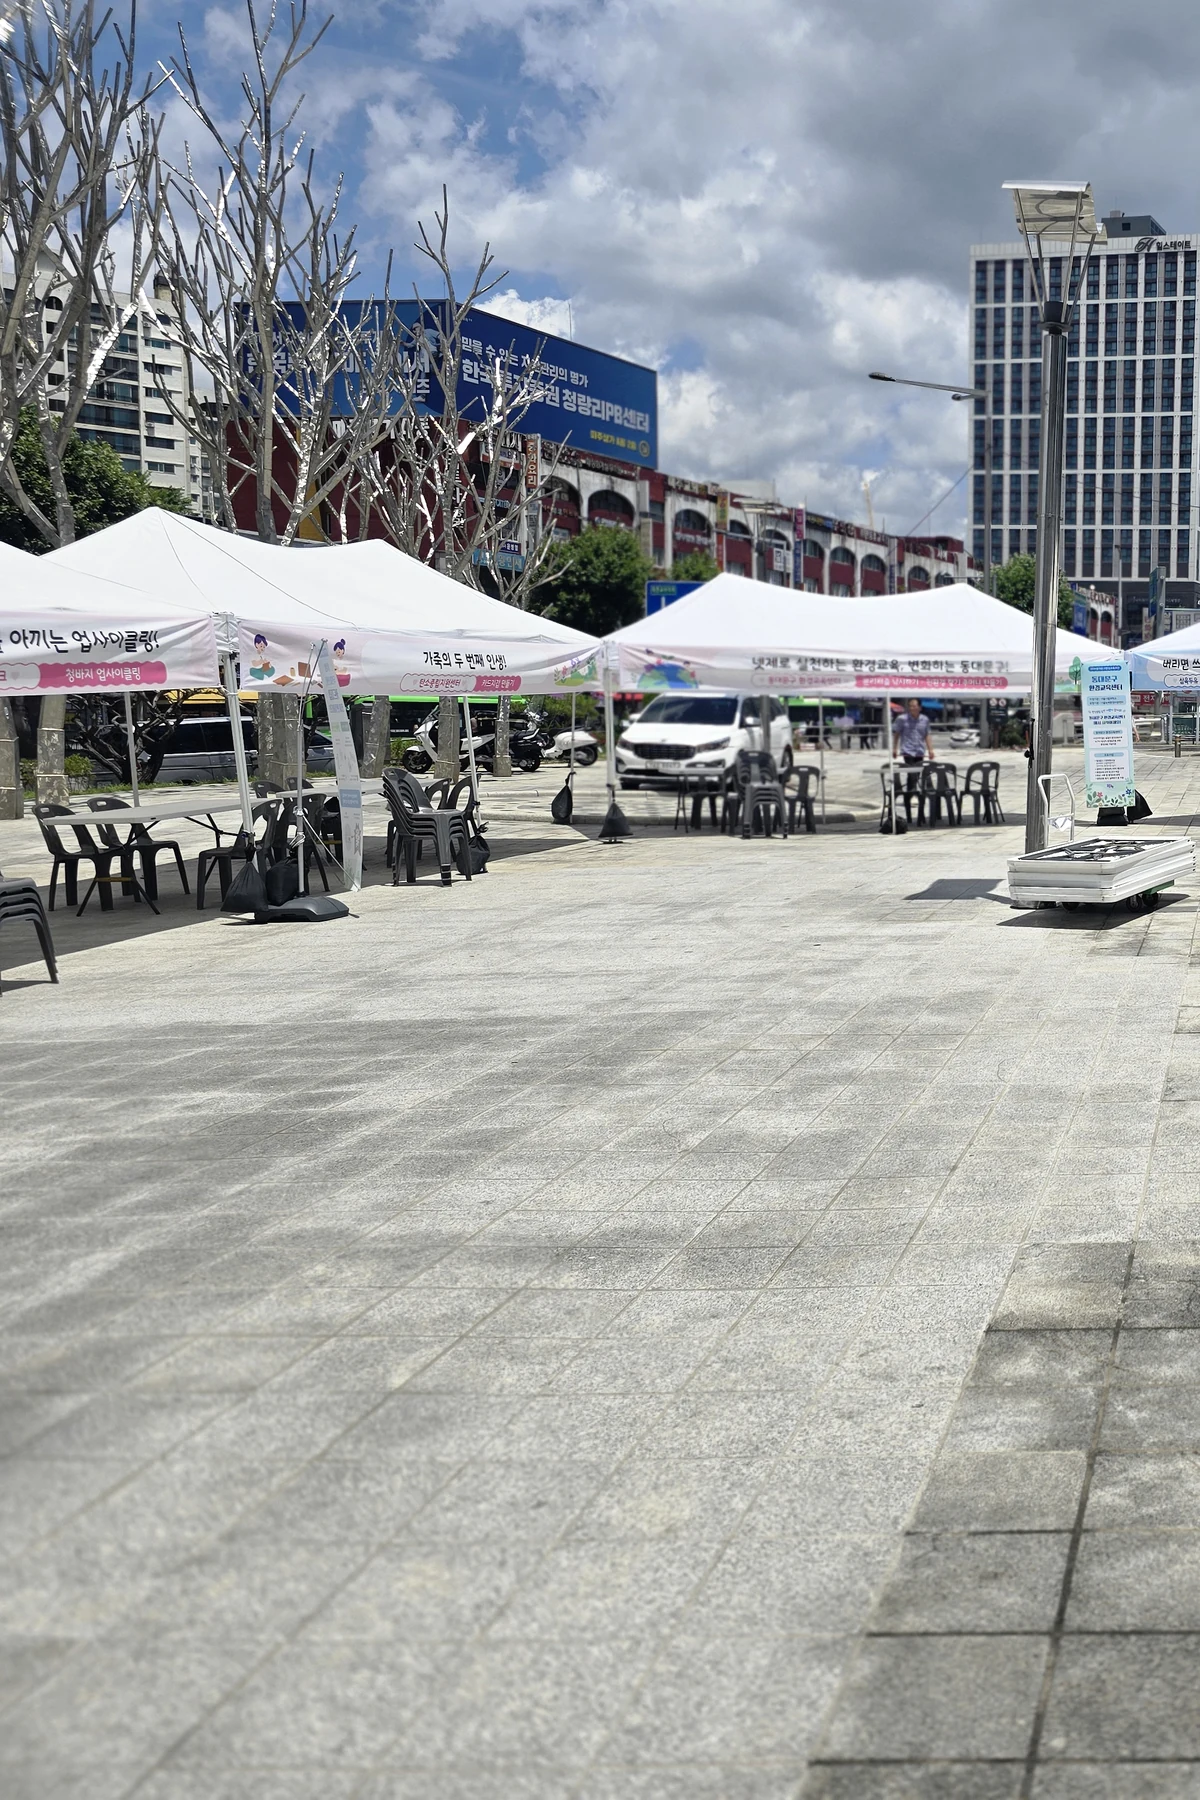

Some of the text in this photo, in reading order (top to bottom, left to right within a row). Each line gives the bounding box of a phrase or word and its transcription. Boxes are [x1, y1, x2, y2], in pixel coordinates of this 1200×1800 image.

[1156, 240, 1191, 251] 힐스테이트
[462, 336, 482, 355] 믿을
[486, 344, 496, 358] 수
[499, 348, 518, 366] 있는
[570, 371, 588, 388] 명가
[562, 389, 650, 433] 청량리PB센터
[9, 629, 160, 653] 아끼는 업사이클링!
[423, 651, 507, 671] 가죽의 두 번째 인생!
[751, 657, 1009, 674] 넷제로 실천하는 환경교육, 변화하는 동대문구!
[1162, 659, 1189, 670] 버리면
[65, 667, 141, 682] 청바지 업사이클링
[419, 679, 461, 688] 탄소중립지원센터
[481, 679, 515, 688] 카드지갑 만들기
